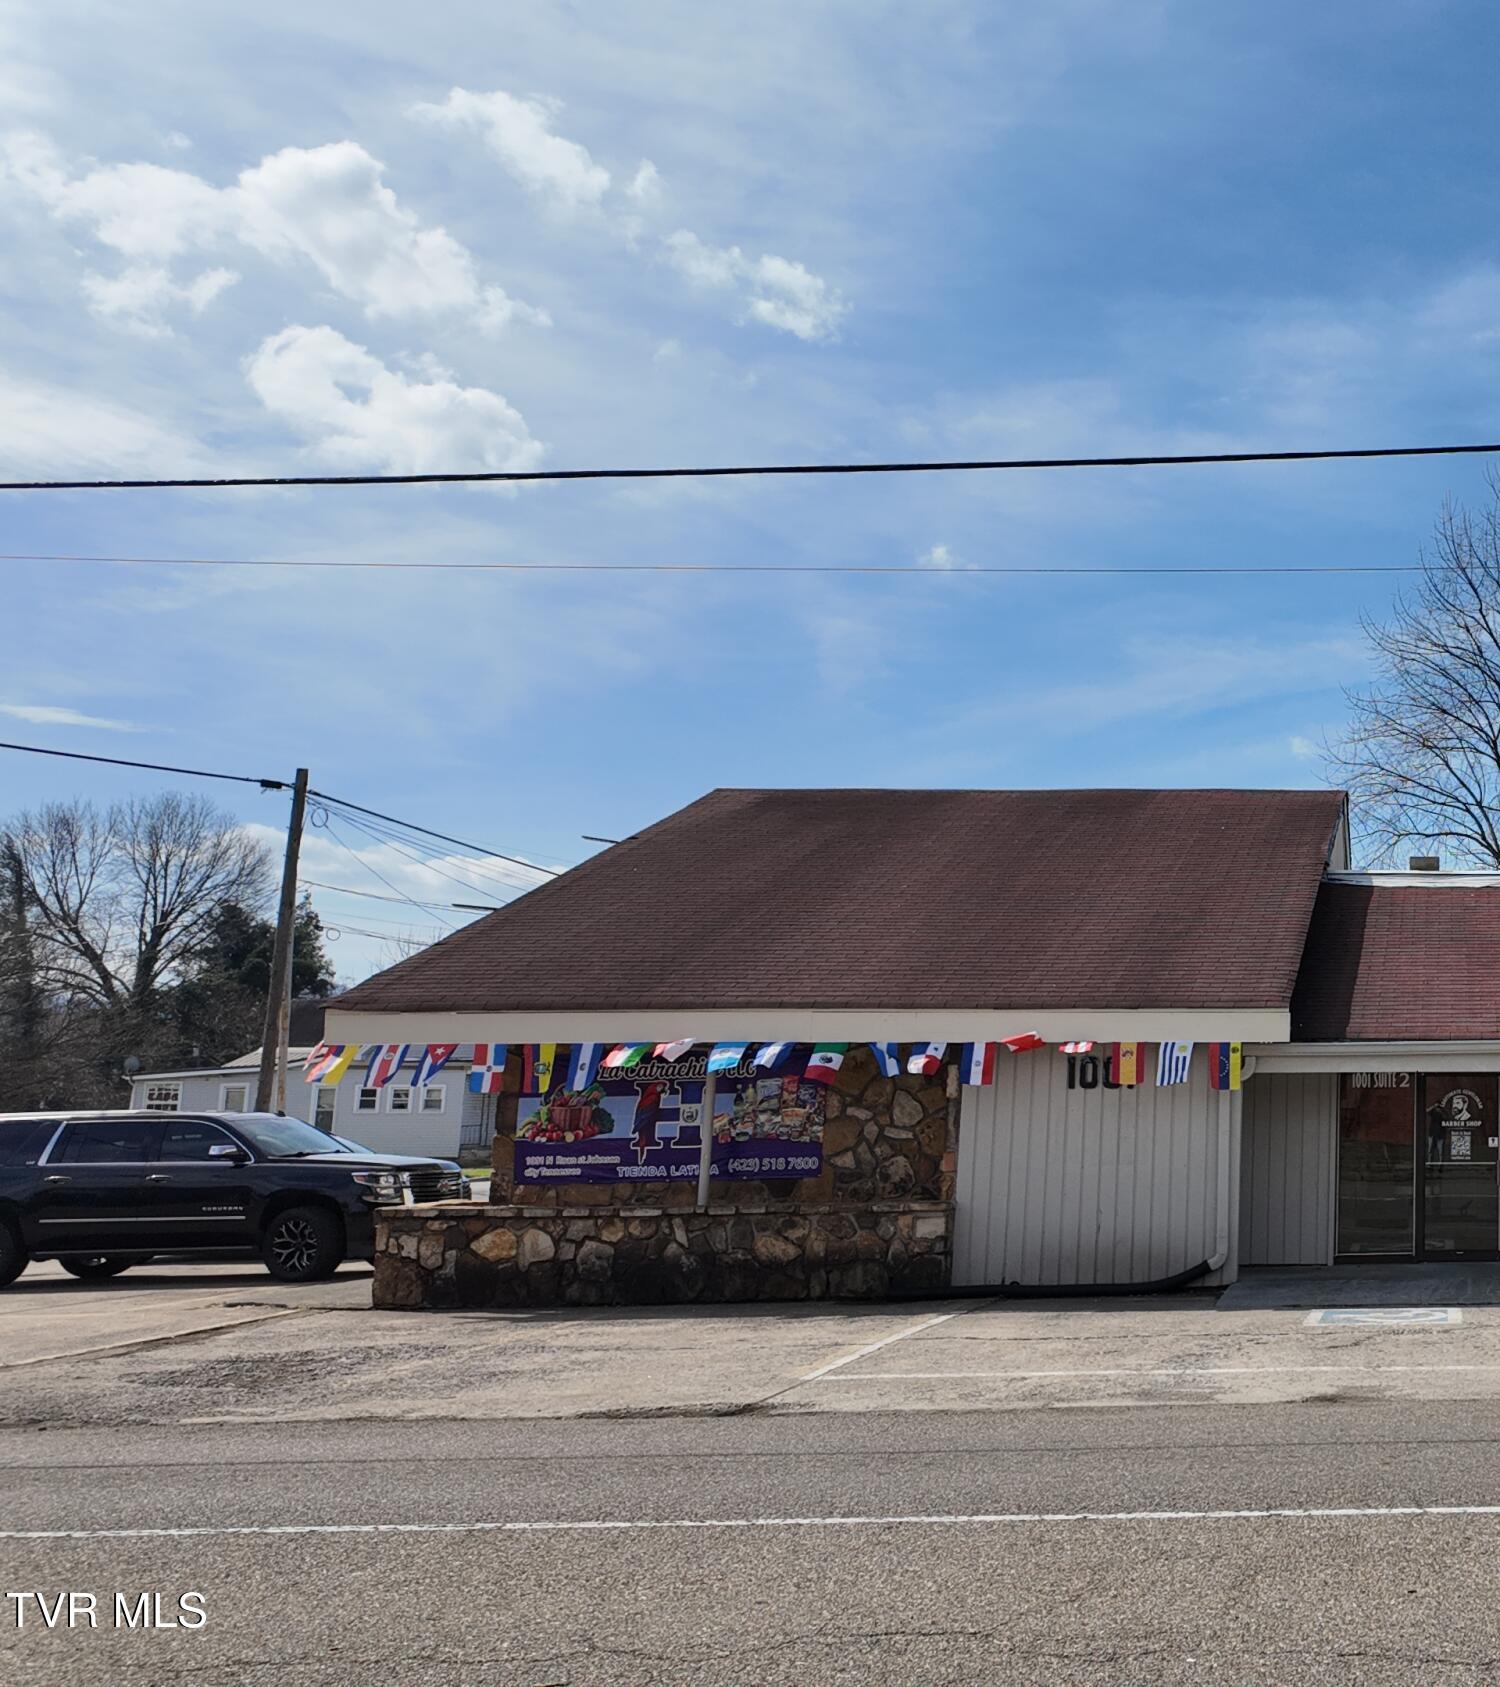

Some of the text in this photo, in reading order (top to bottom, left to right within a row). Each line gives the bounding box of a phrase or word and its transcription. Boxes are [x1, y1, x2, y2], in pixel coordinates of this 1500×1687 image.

[1067, 1056, 1136, 1089] 100
[1352, 1072, 1410, 1088] 1001 SUITE 2
[617, 1164, 719, 1177] TIENDA LATIA
[728, 1156, 819, 1173] (423) 518 7600
